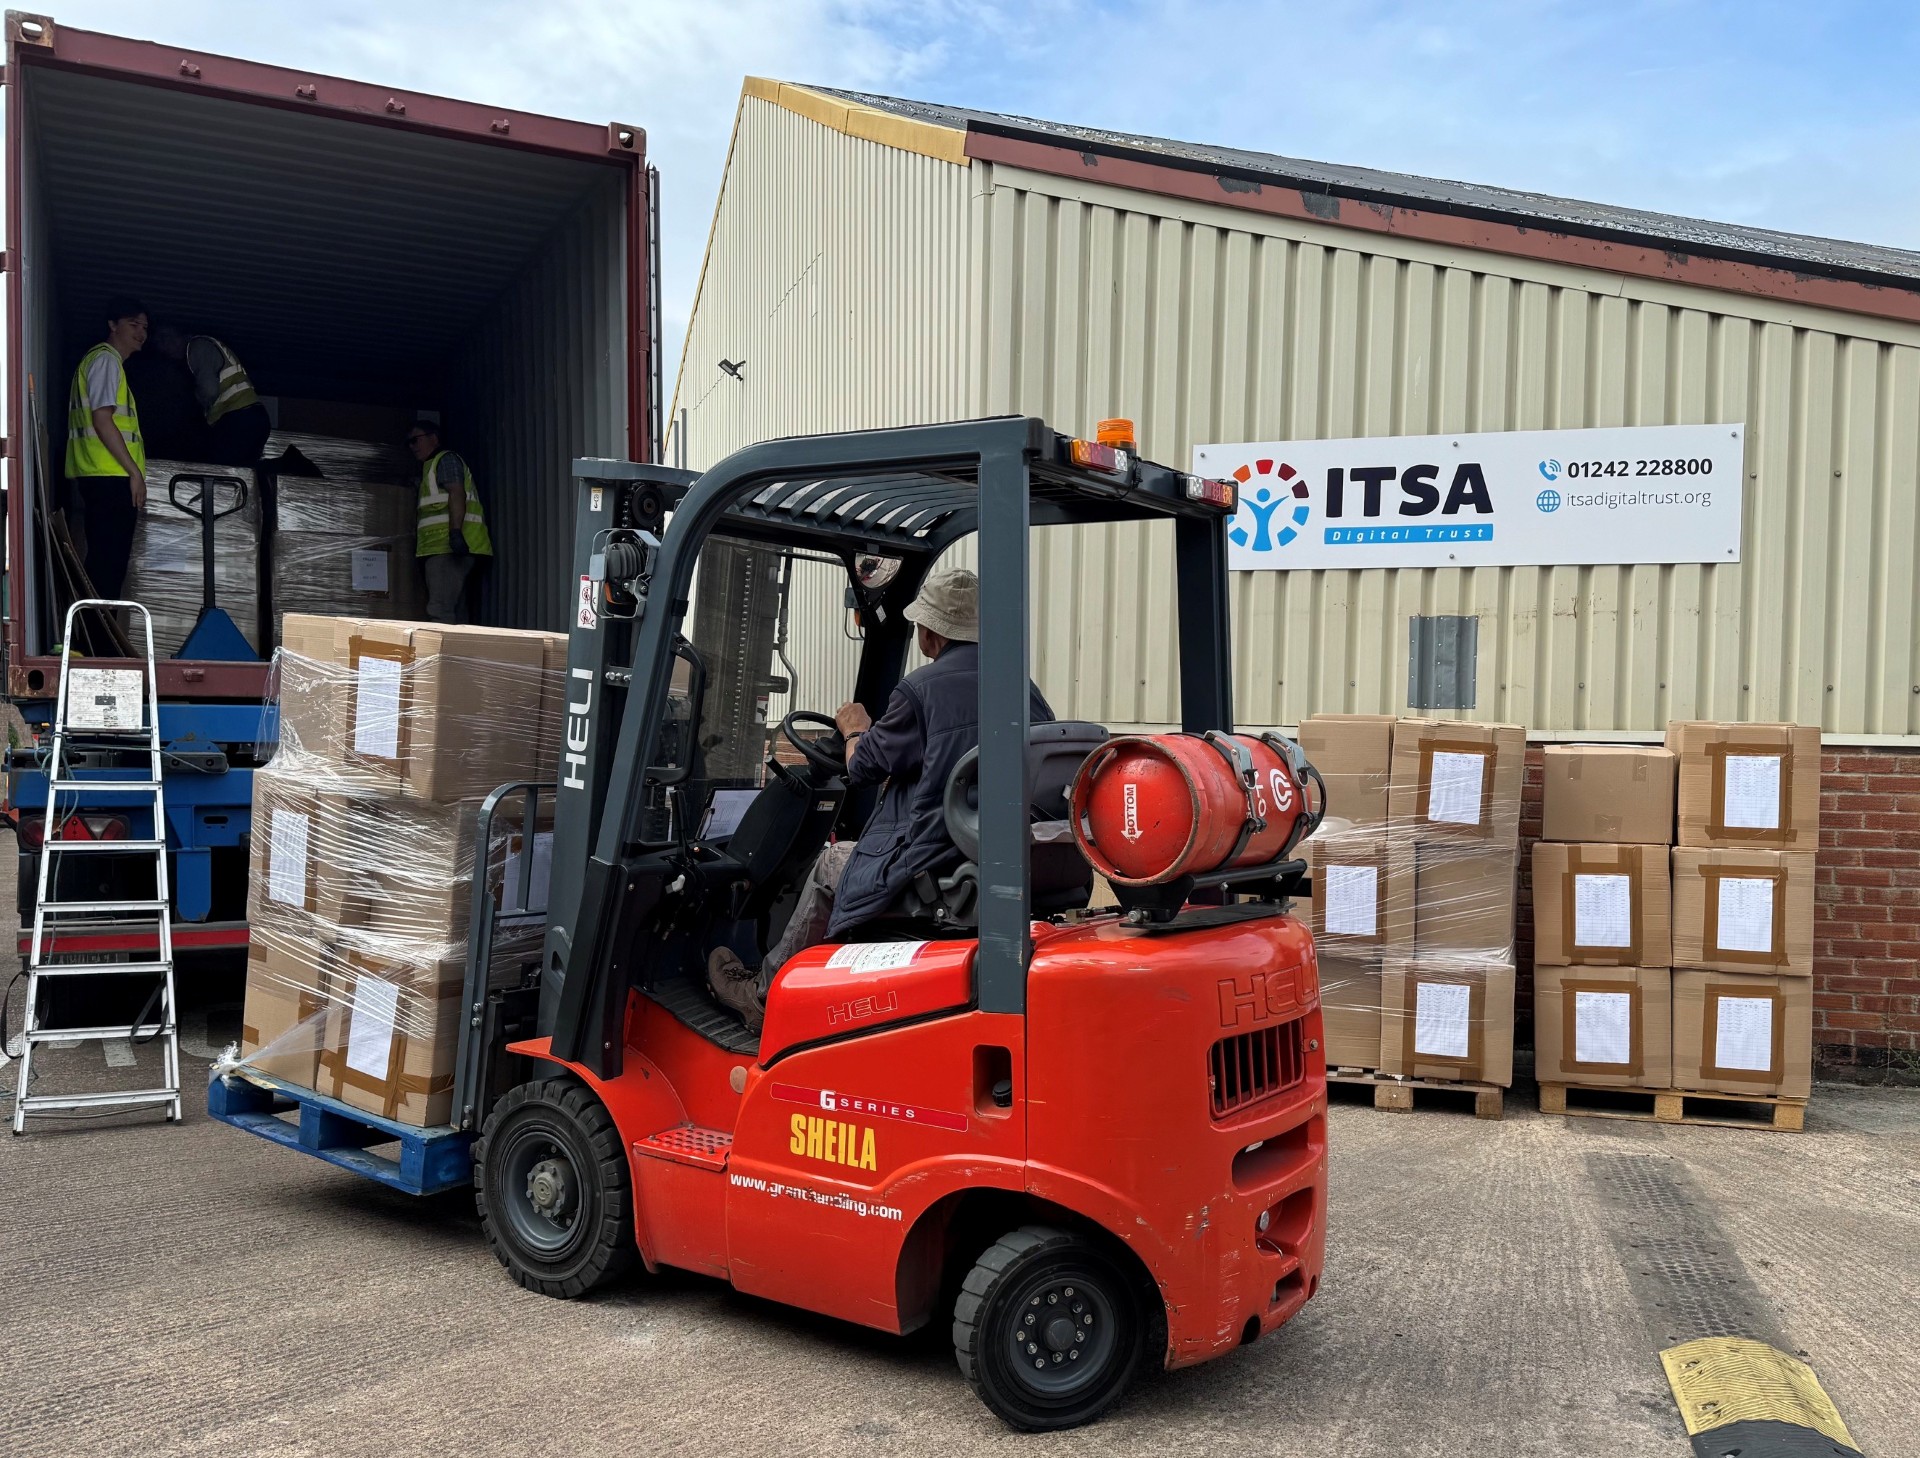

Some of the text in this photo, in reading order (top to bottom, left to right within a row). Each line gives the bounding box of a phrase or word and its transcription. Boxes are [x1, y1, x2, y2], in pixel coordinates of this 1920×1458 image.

[1567, 458, 1713, 478] 01242 228800
[1326, 463, 1494, 518] ITSA
[1567, 490, 1712, 509] itsadigitaltrust.org
[1333, 528, 1483, 543] Digital Trust
[563, 667, 593, 790] HELI
[1126, 787, 1136, 835] BOTTOM
[827, 991, 898, 1025] HELI
[820, 1091, 915, 1118] G SERIES
[790, 1113, 877, 1171] SHEILA
